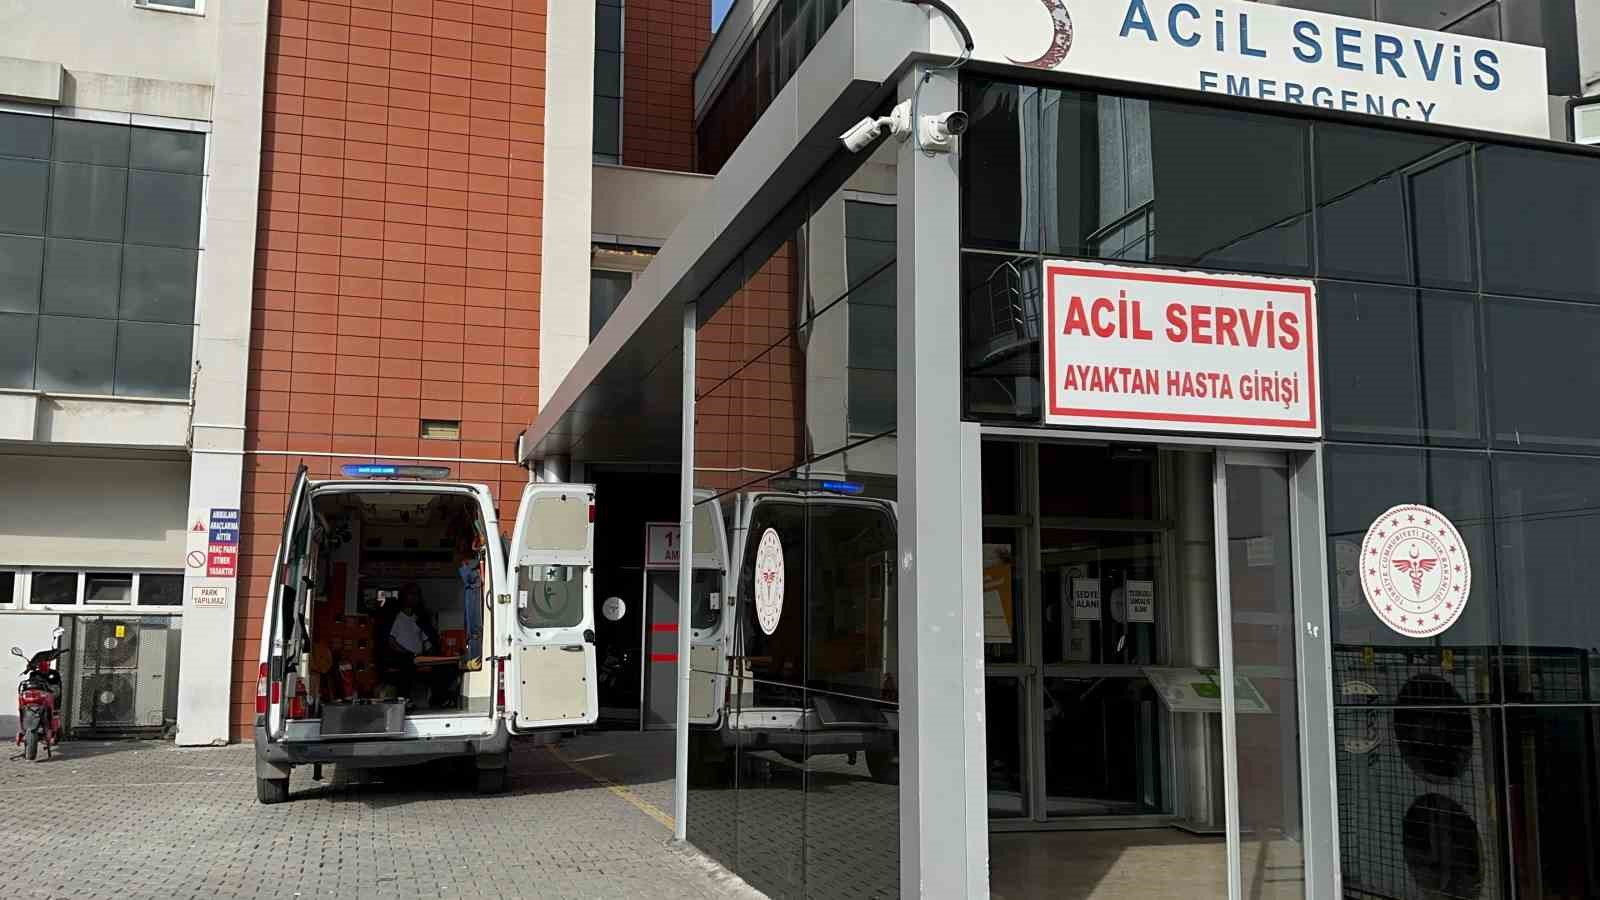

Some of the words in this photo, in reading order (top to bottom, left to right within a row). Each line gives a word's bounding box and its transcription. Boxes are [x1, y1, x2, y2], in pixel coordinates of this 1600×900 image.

[1199, 71, 1437, 122] EMERGENCY
[1063, 289, 1153, 340] ACİL
[1166, 301, 1300, 350] SERVİS
[1063, 364, 1160, 395] AYAKTAN
[1167, 370, 1234, 400] HASTA
[1239, 368, 1300, 409] GİRİŞİ
[194, 597, 225, 605] YAPILMAZ
[201, 589, 218, 597] PARK
